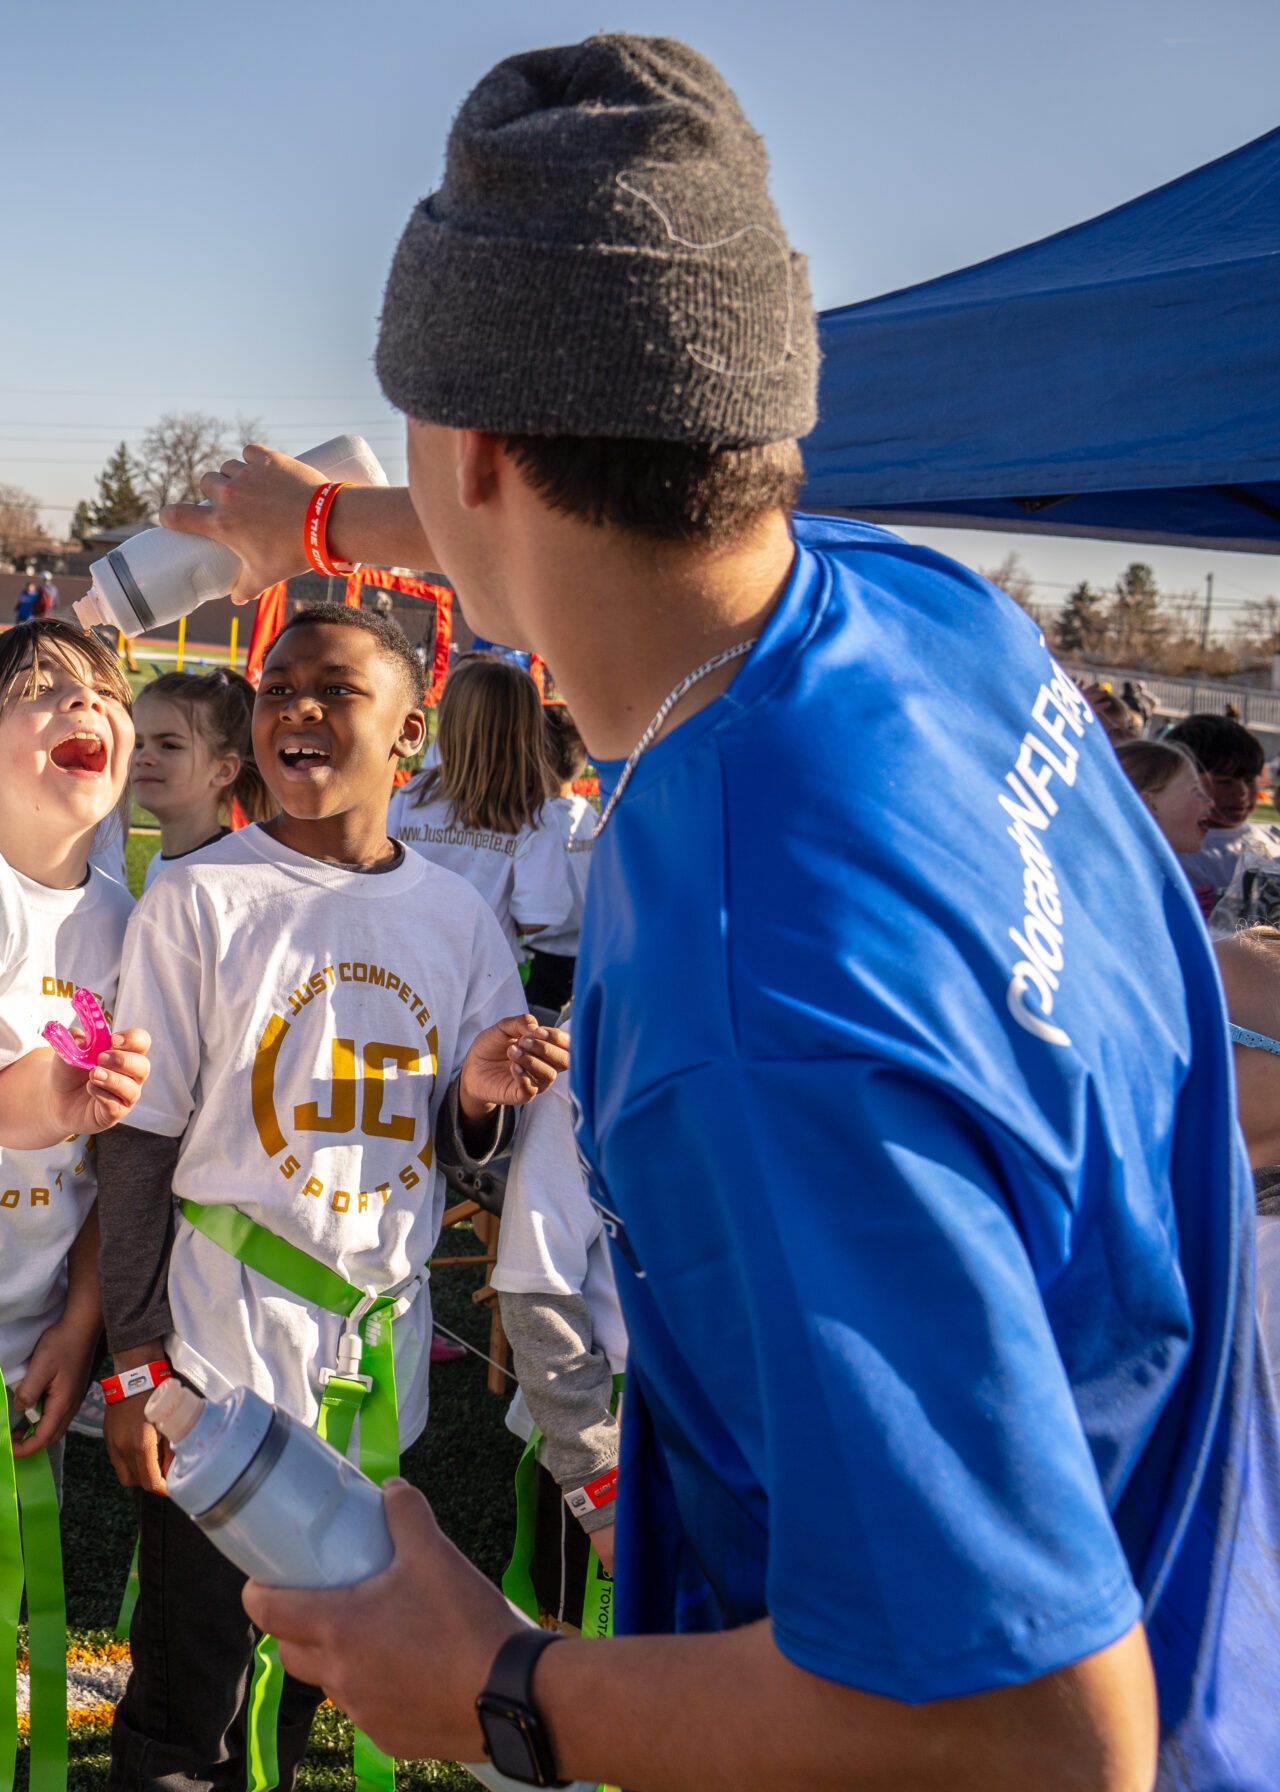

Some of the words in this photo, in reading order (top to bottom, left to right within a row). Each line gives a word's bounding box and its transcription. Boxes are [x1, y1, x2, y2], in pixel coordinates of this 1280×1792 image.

[310, 518, 319, 547] THE
[288, 965, 334, 1016] JUST
[339, 962, 431, 1027] COMPETE
[293, 1037, 420, 1141] JC
[279, 1154, 420, 1213] SPORTS
